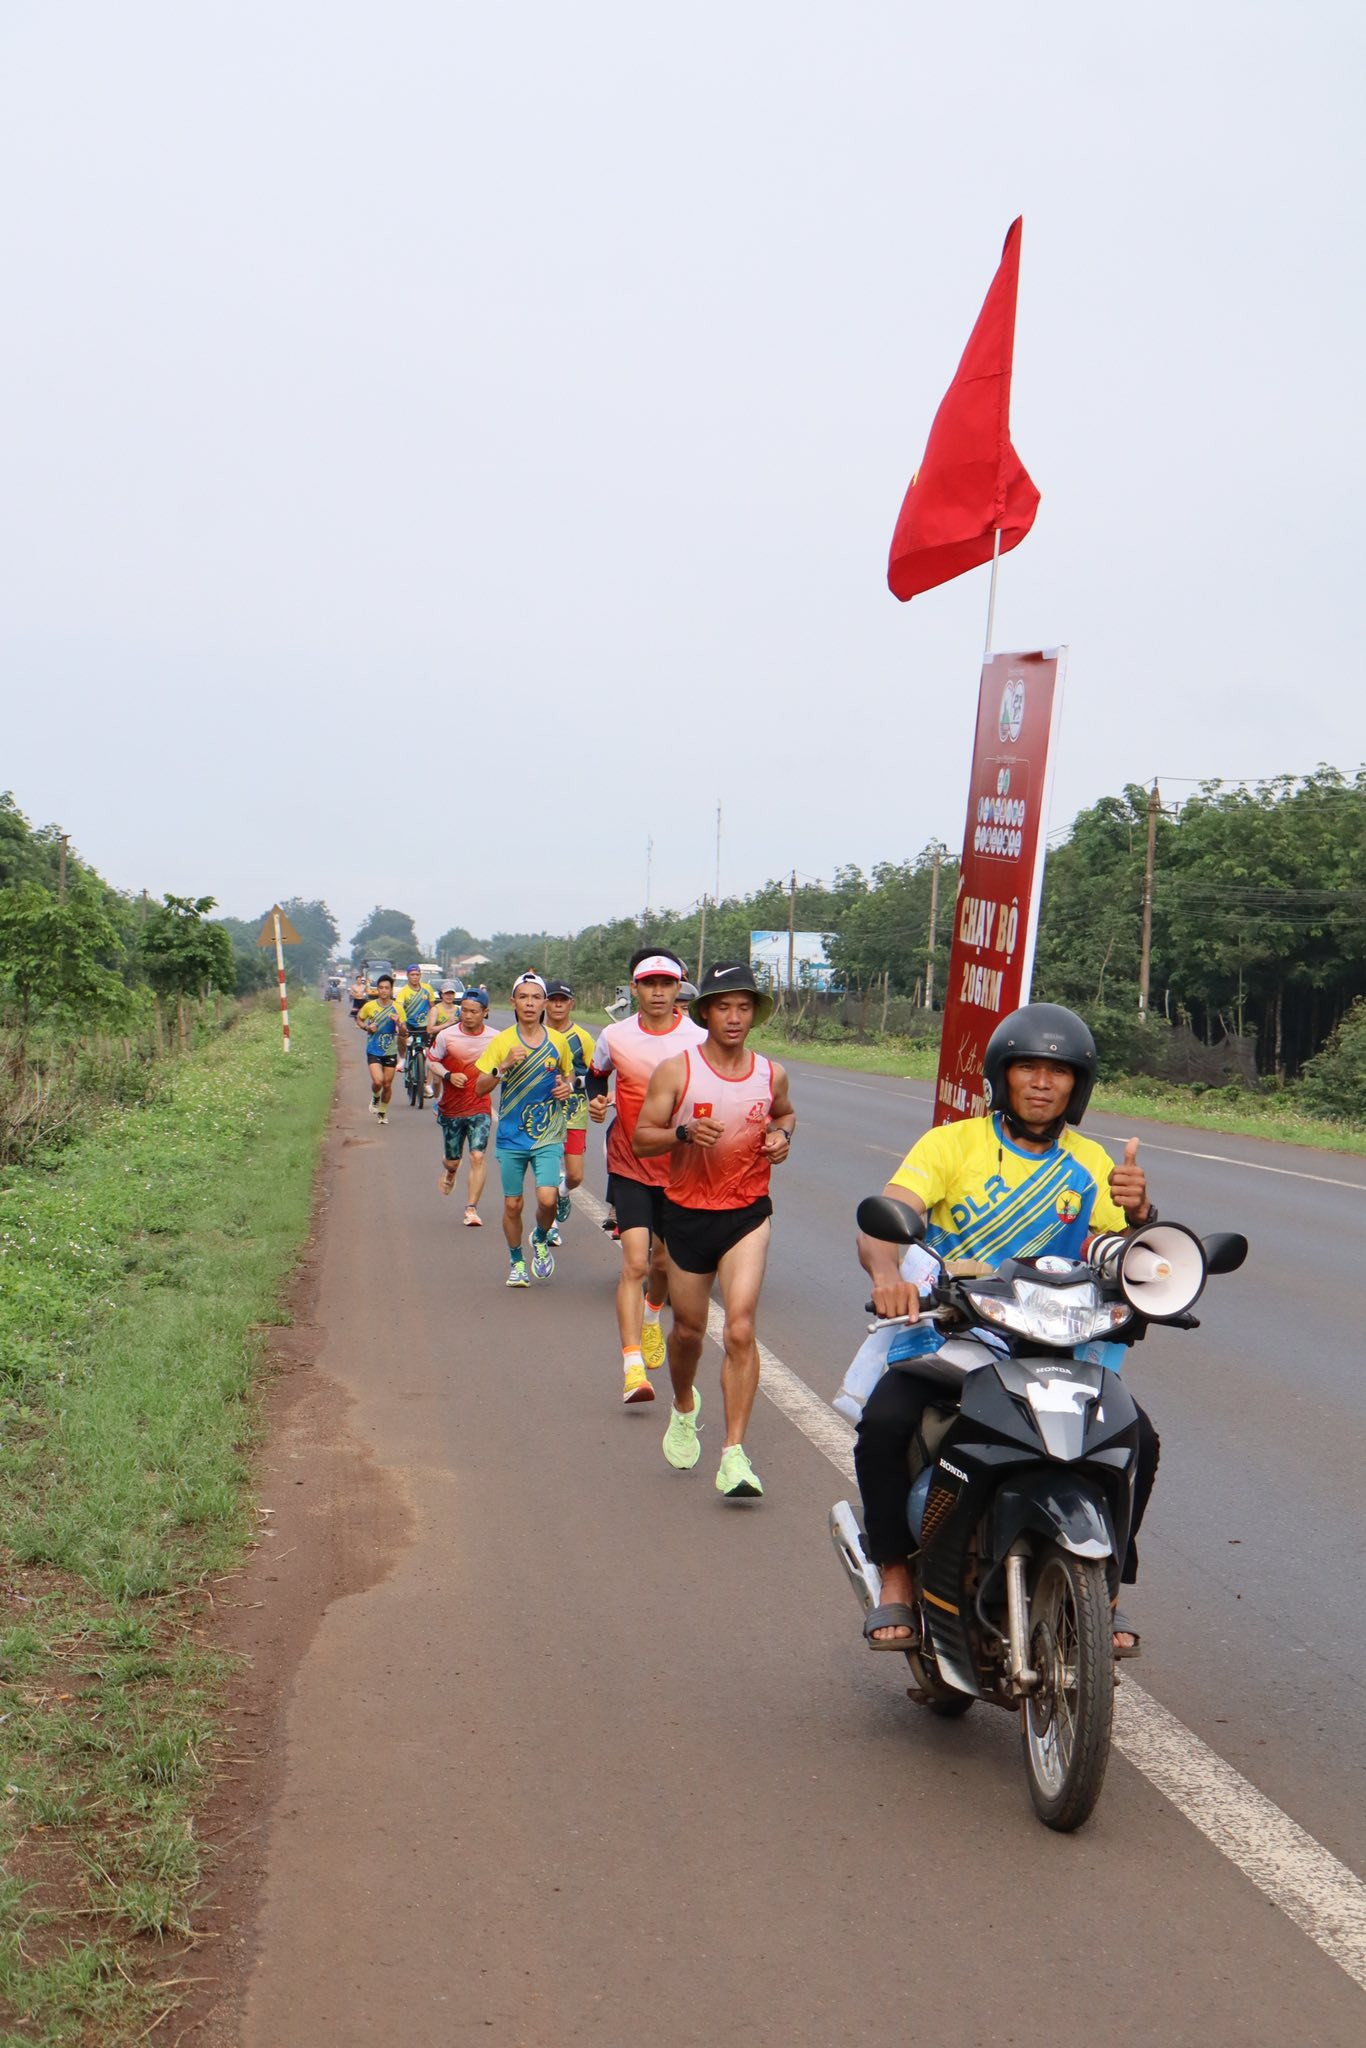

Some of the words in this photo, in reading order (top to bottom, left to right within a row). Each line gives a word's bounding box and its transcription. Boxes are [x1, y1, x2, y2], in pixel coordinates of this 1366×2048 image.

[960, 896, 996, 955] CHẠY
[995, 896, 1018, 965] BỘ
[960, 962, 1003, 1012] 206KM
[950, 1174, 1012, 1231] DLR
[1035, 1366, 1073, 1375] HONDA
[939, 1457, 970, 1483] HONDA
